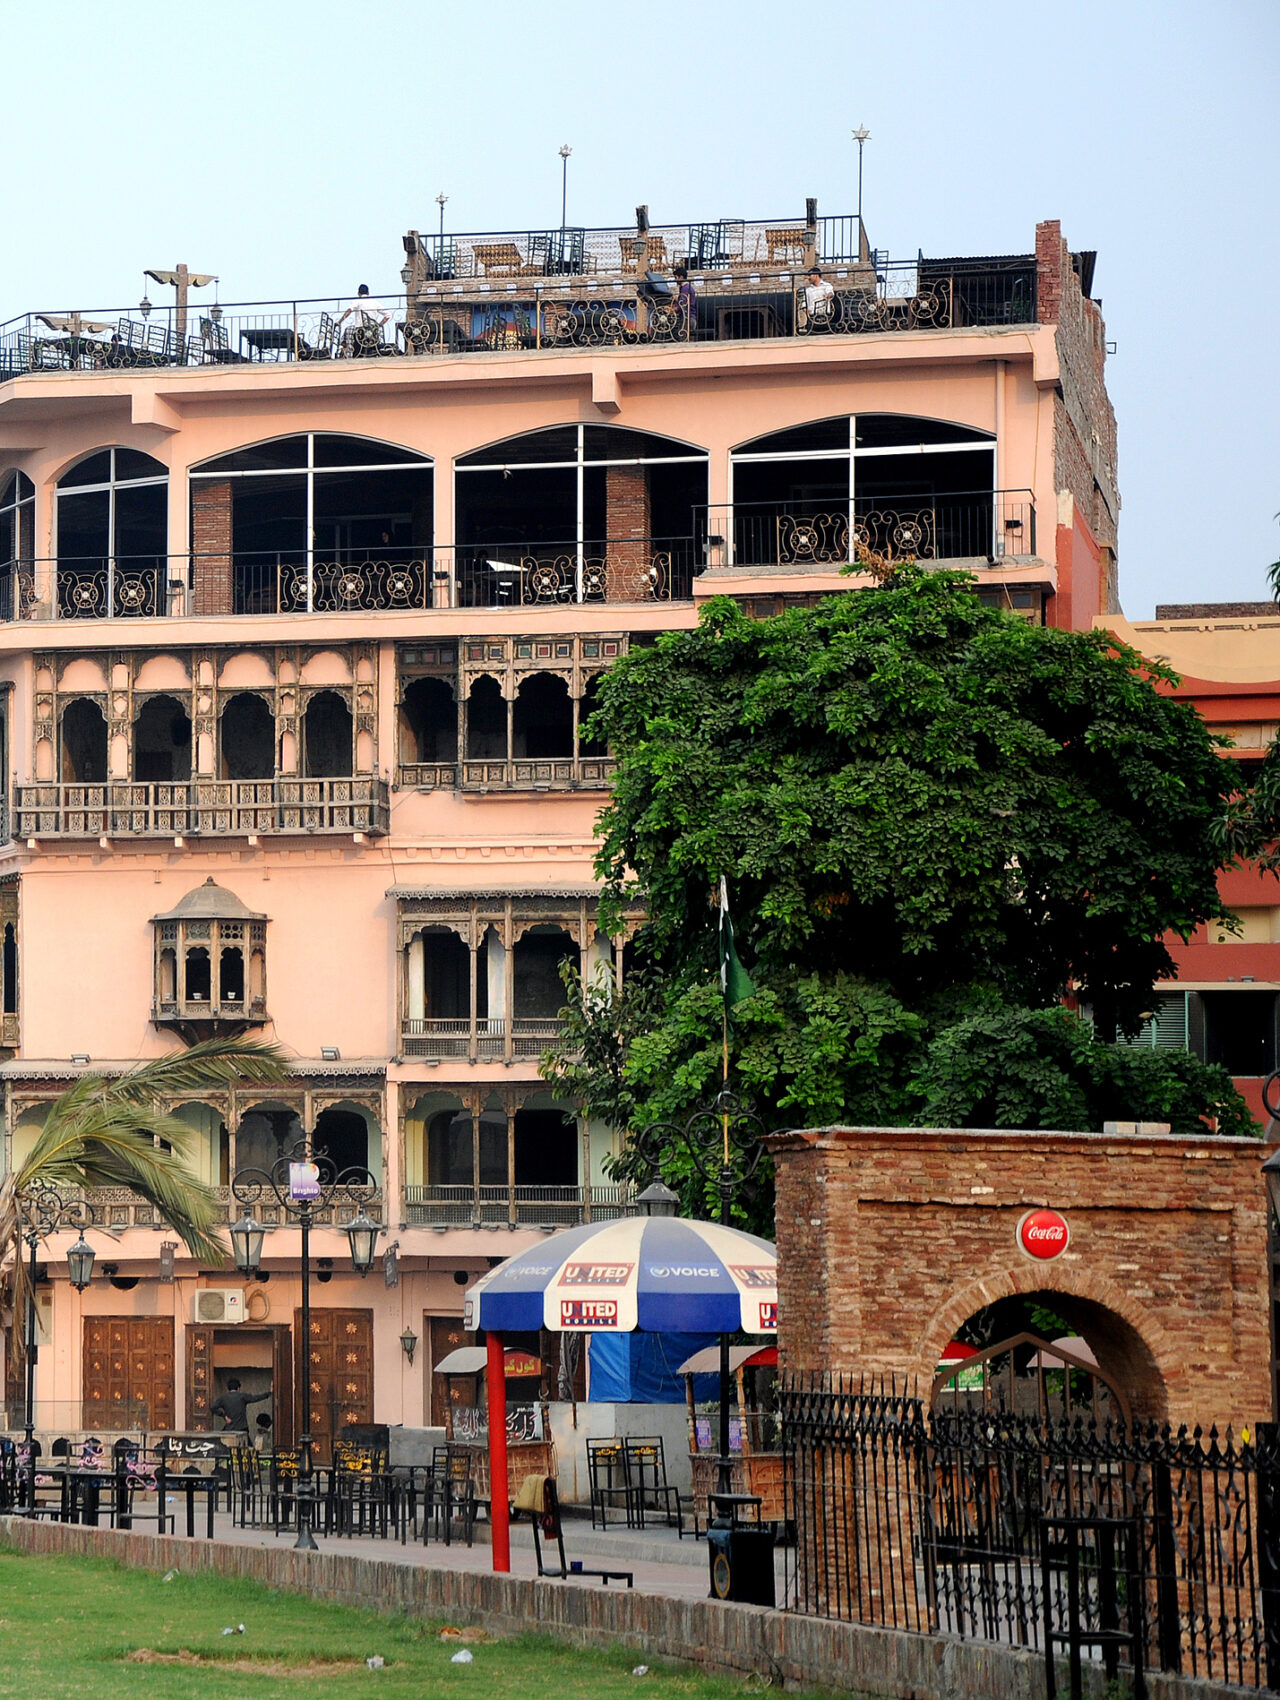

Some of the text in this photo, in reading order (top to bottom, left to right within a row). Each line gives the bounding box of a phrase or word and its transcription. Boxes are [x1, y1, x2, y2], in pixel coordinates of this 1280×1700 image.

[565, 1266, 629, 1278] UNITED
[670, 1267, 720, 1278] VOICE
[562, 1302, 616, 1317] UNITED
